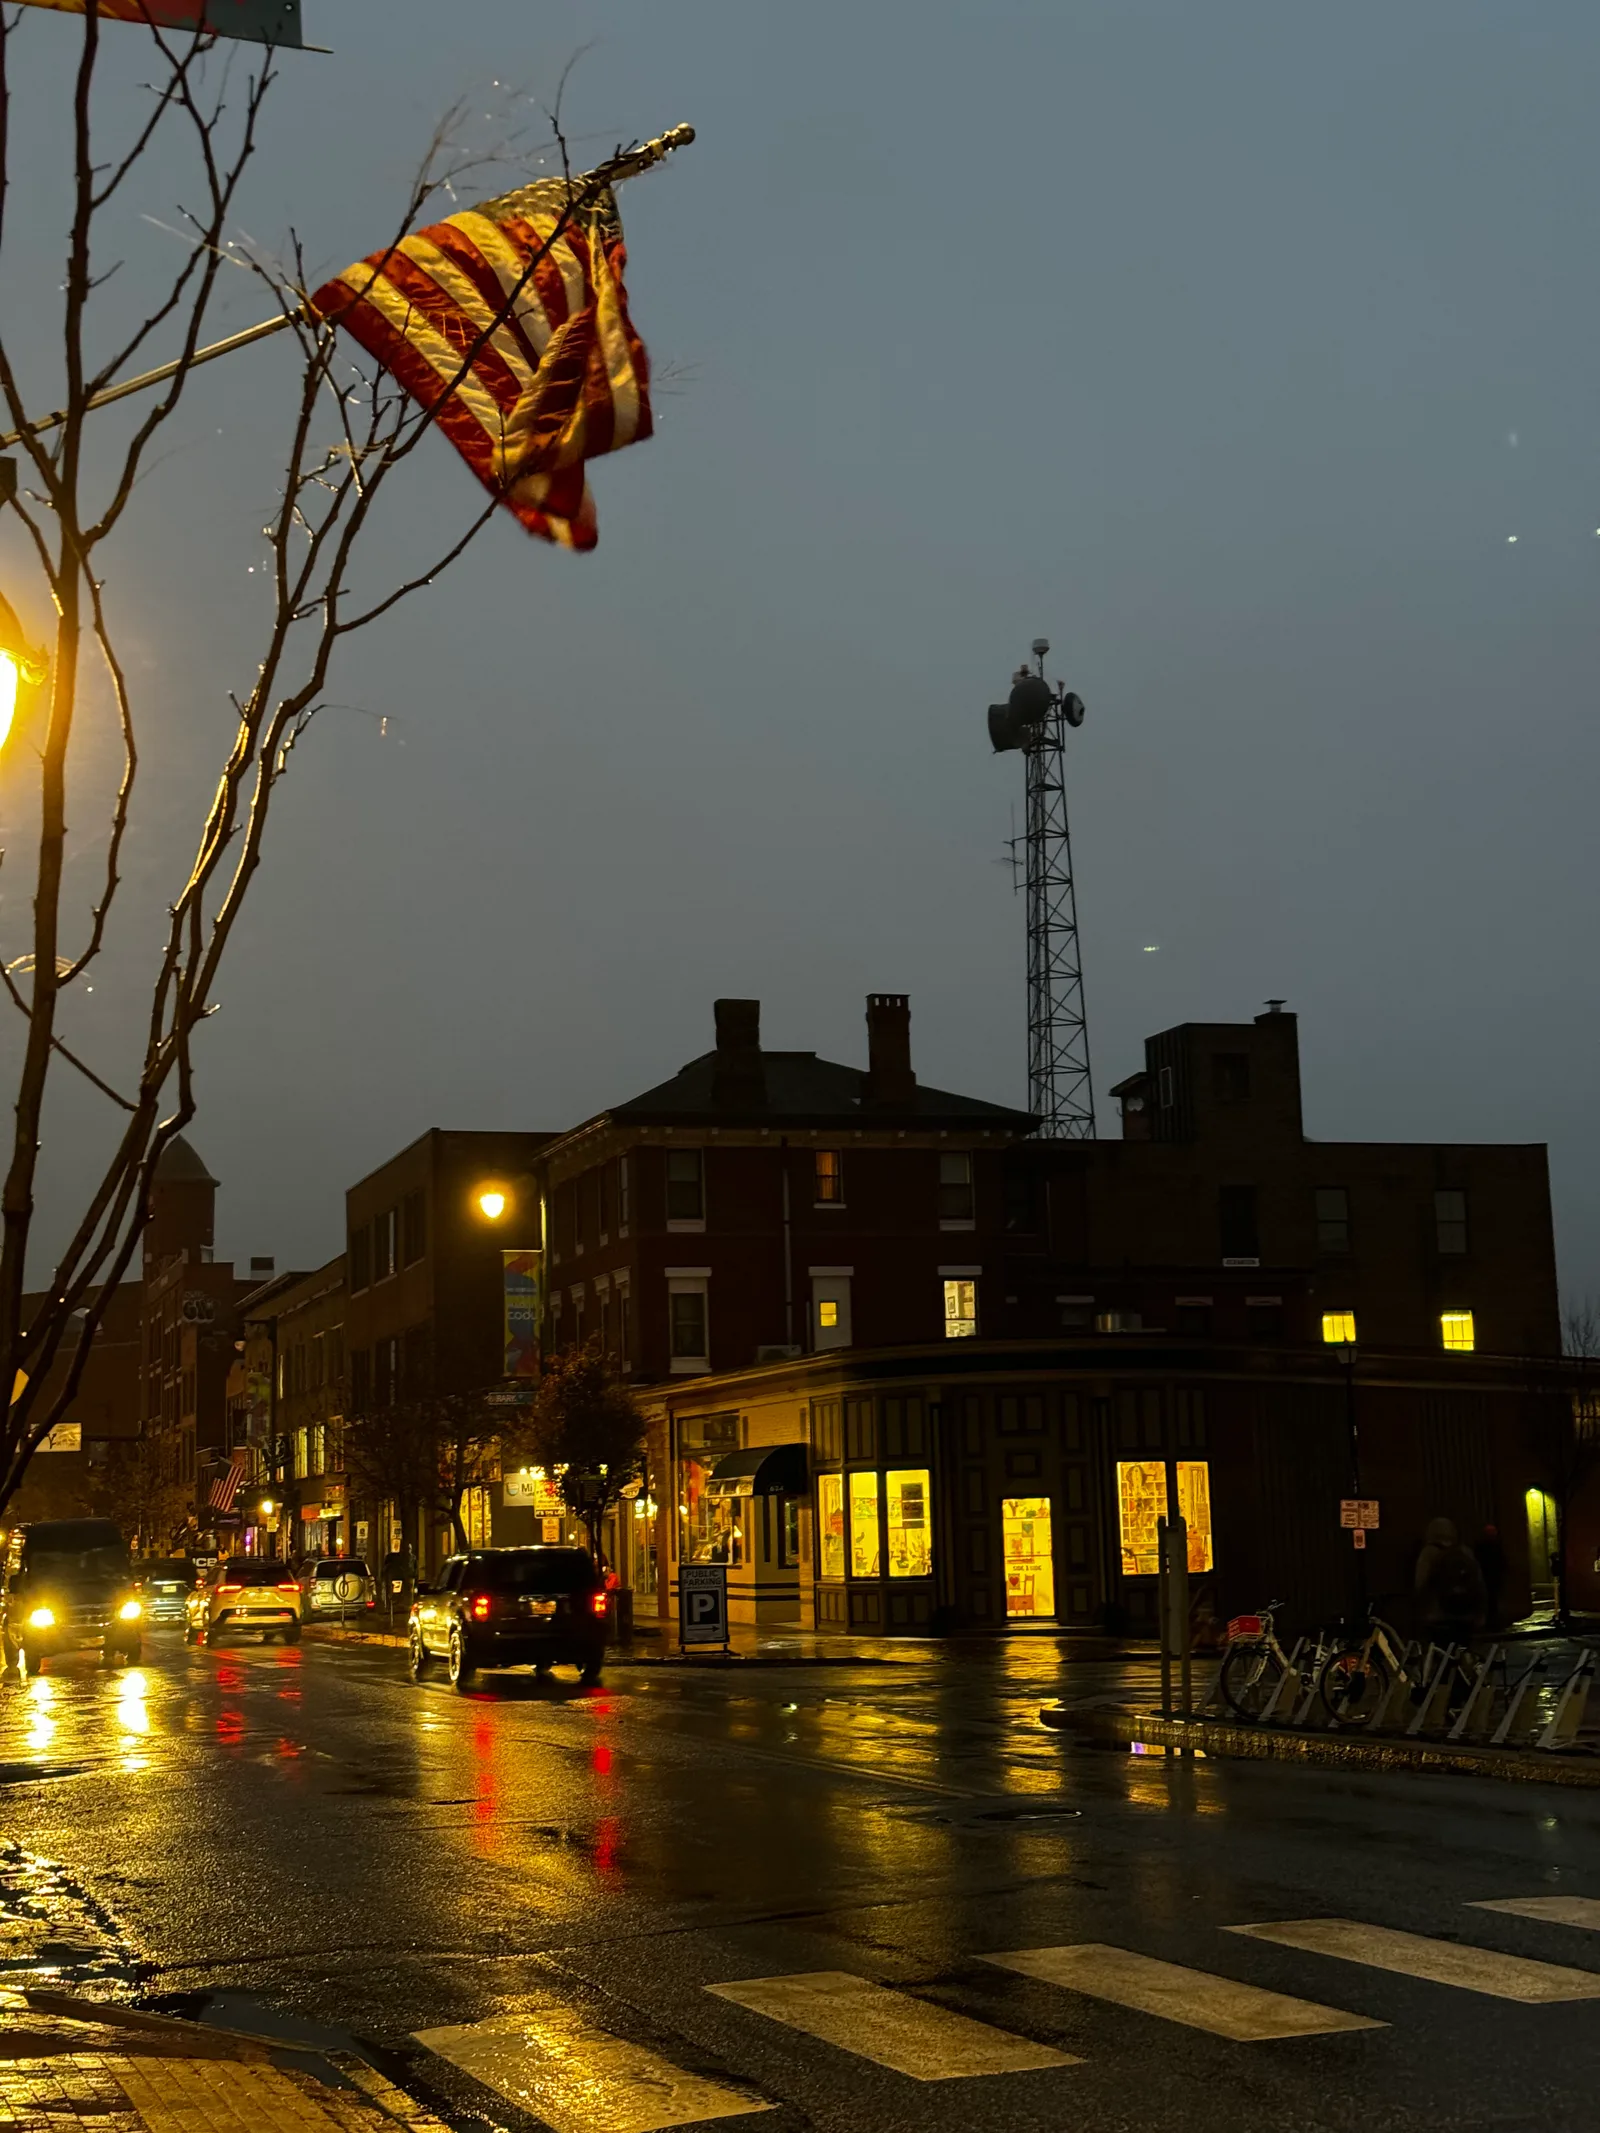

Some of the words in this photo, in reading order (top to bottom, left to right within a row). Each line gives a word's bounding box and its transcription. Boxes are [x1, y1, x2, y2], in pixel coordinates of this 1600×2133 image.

[686, 1569, 719, 1579] PUBLIC
[684, 1577, 721, 1586] PARKING
[692, 1593, 715, 1622] P
